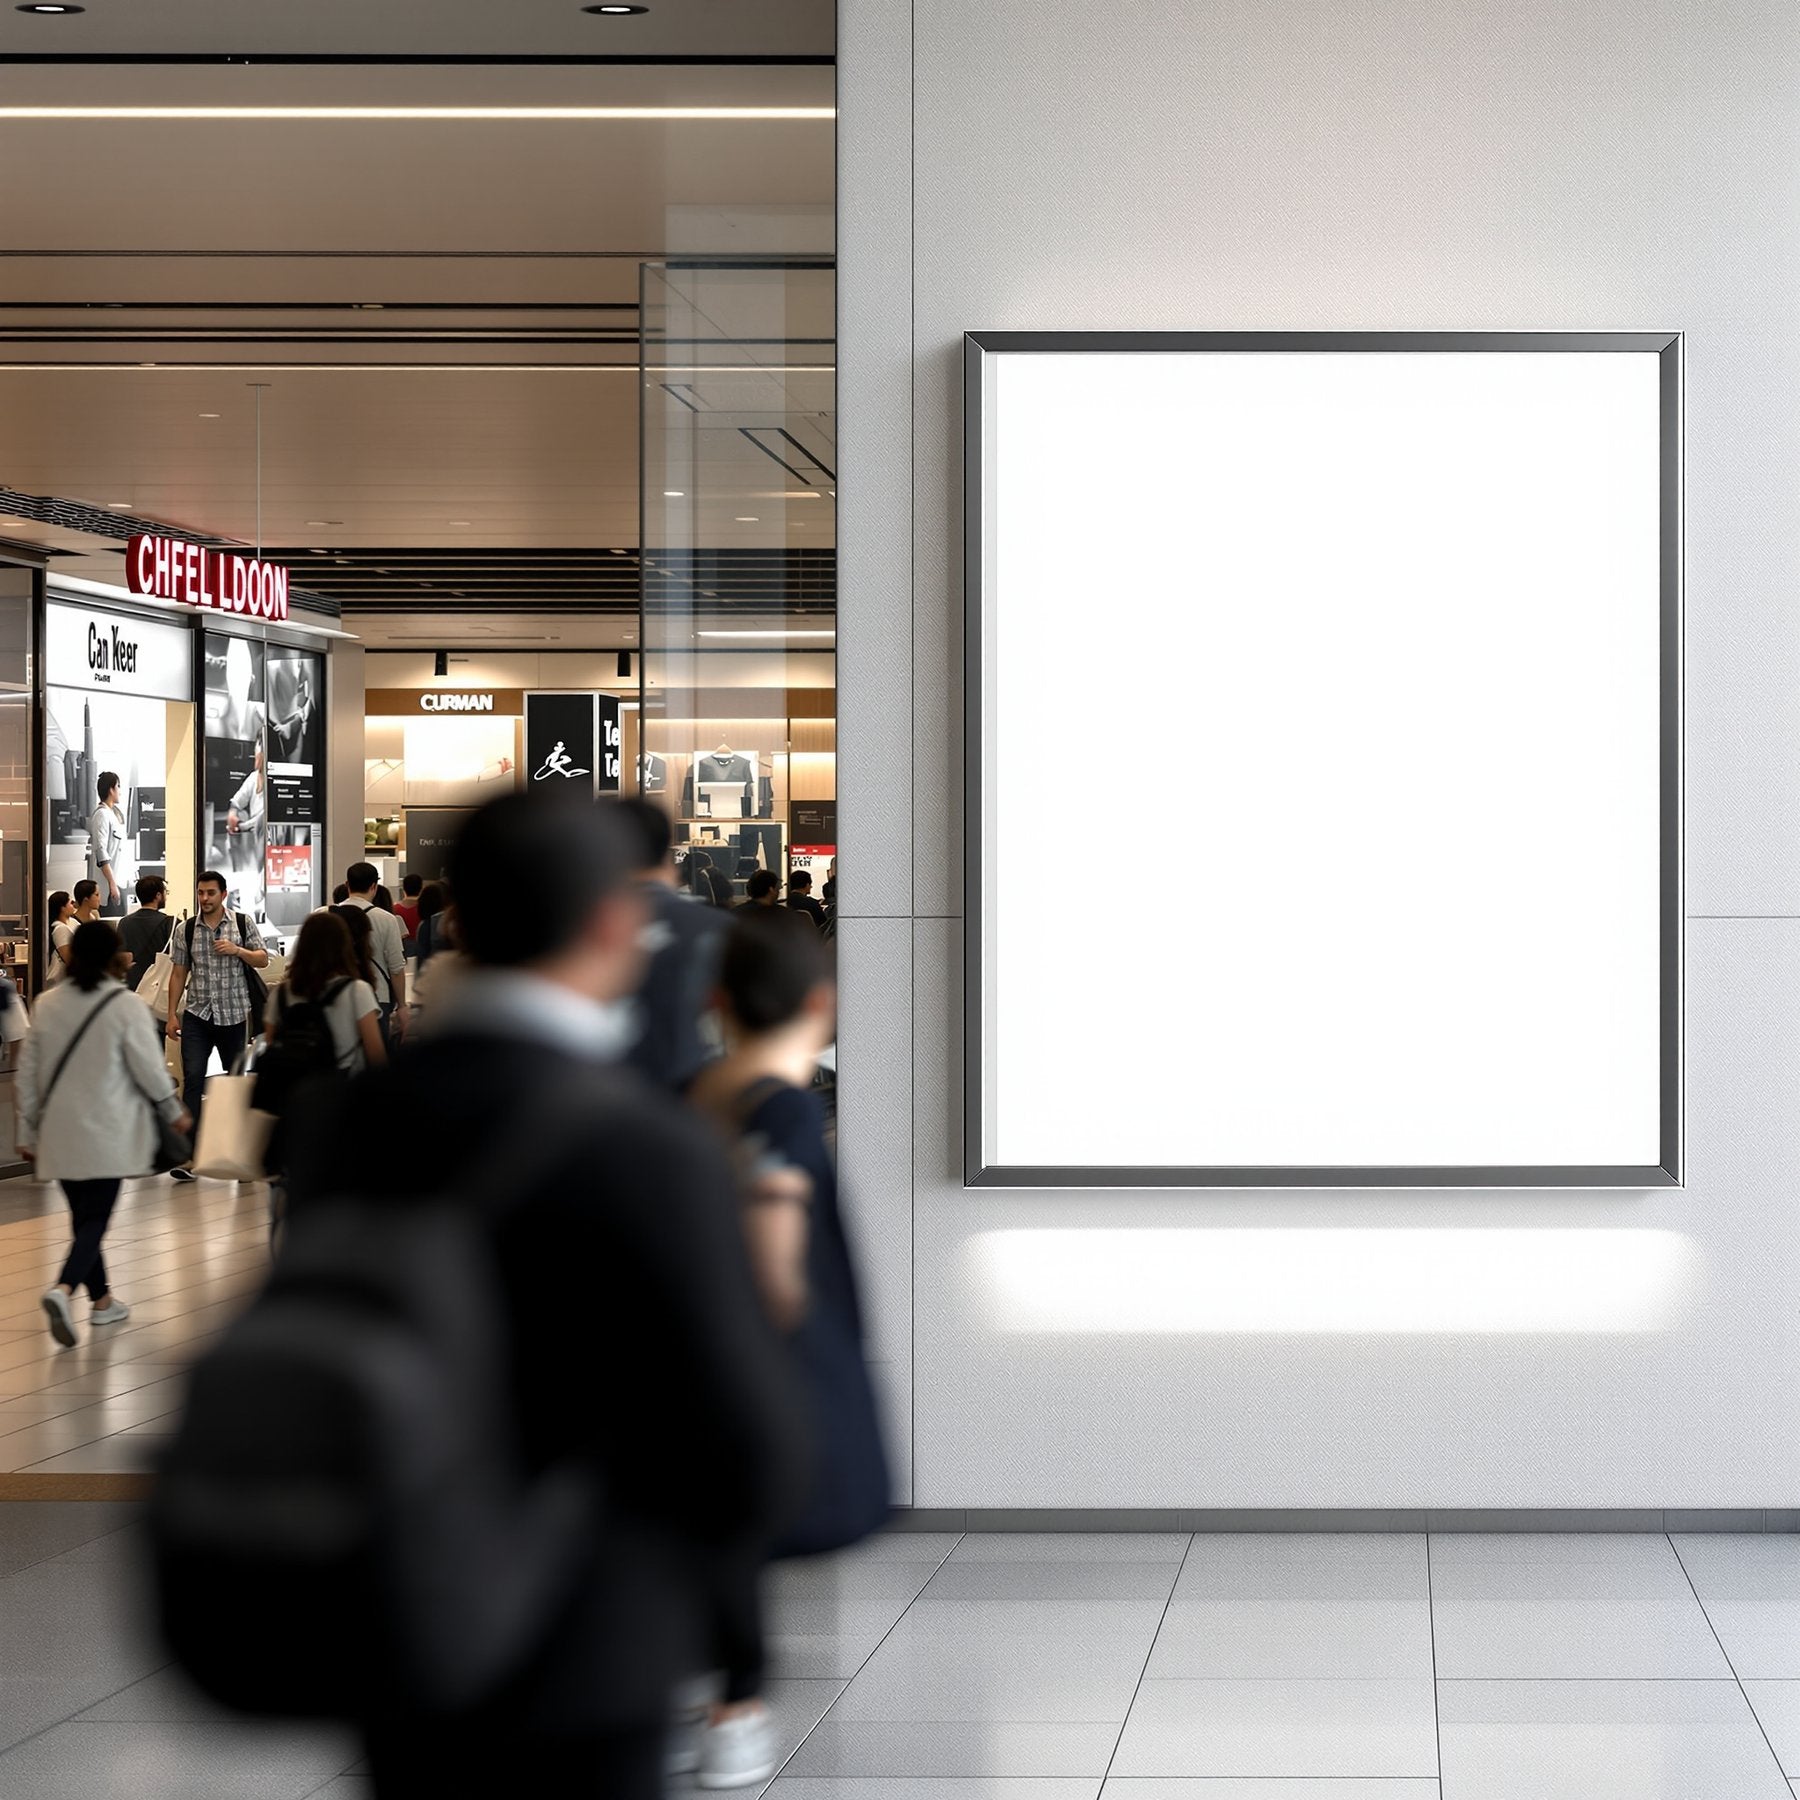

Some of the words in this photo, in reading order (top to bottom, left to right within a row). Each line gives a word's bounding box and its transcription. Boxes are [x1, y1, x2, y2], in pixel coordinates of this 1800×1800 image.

[138, 535, 213, 605] CHFEL
[219, 553, 287, 619] LDOON
[88, 621, 109, 669] Can
